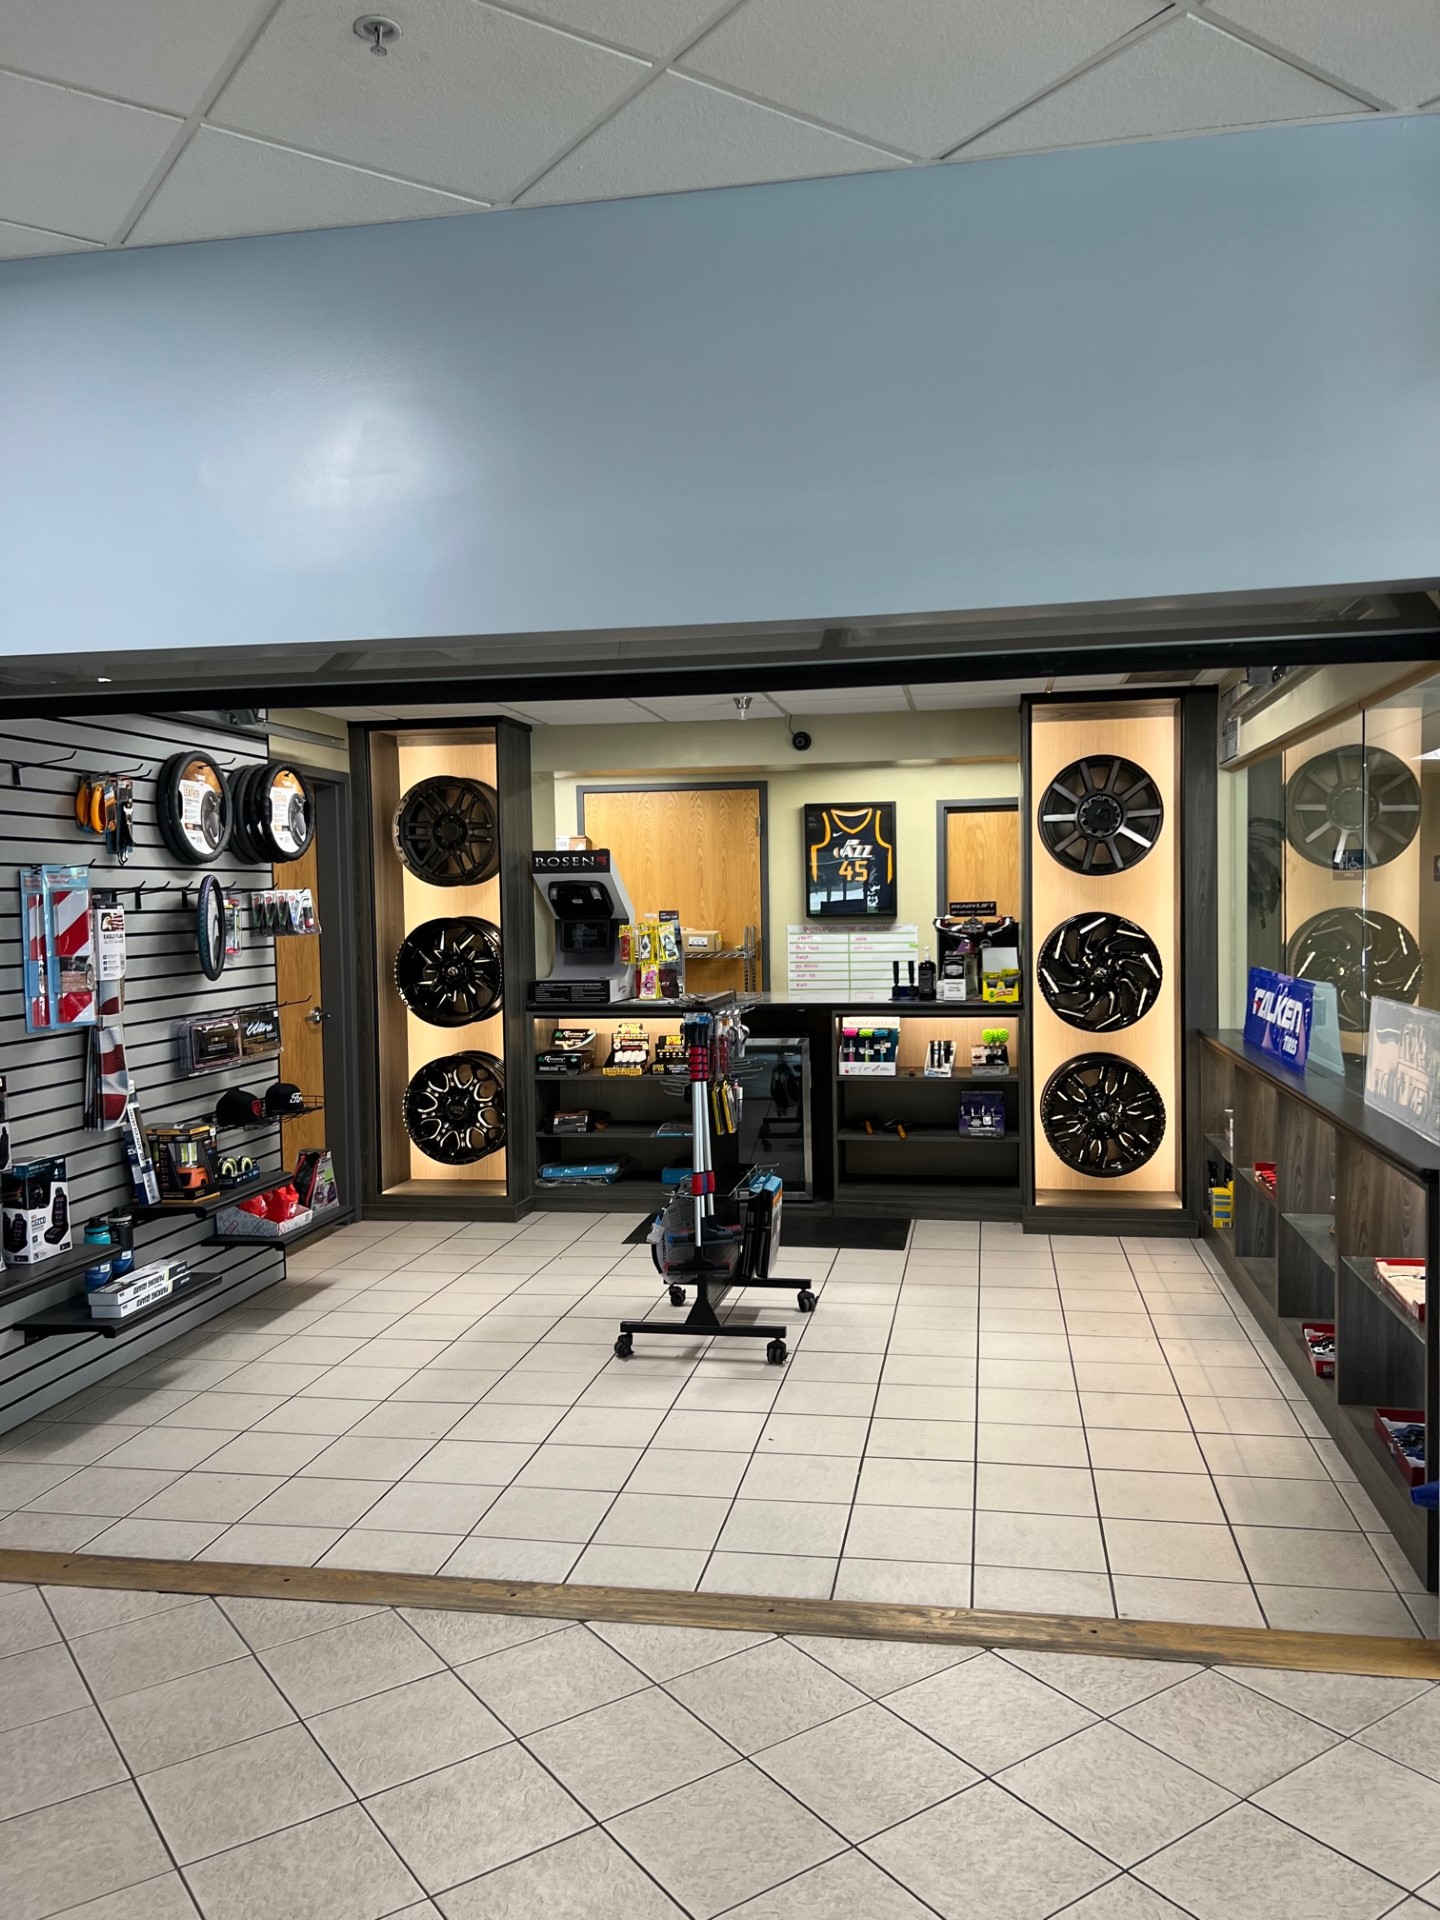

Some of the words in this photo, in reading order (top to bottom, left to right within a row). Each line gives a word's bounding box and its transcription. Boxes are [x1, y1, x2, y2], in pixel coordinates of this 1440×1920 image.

[836, 839, 873, 858] JAZZ
[535, 856, 595, 867] ROSEN
[838, 860, 868, 881] 45
[1252, 987, 1303, 1034] FALKEN
[1282, 1035, 1298, 1056] TIRES
[133, 1282, 147, 1295] GUARD
[147, 1274, 165, 1289] PARKING
[136, 1293, 151, 1307] GUARD
[151, 1286, 169, 1301] PARKING
